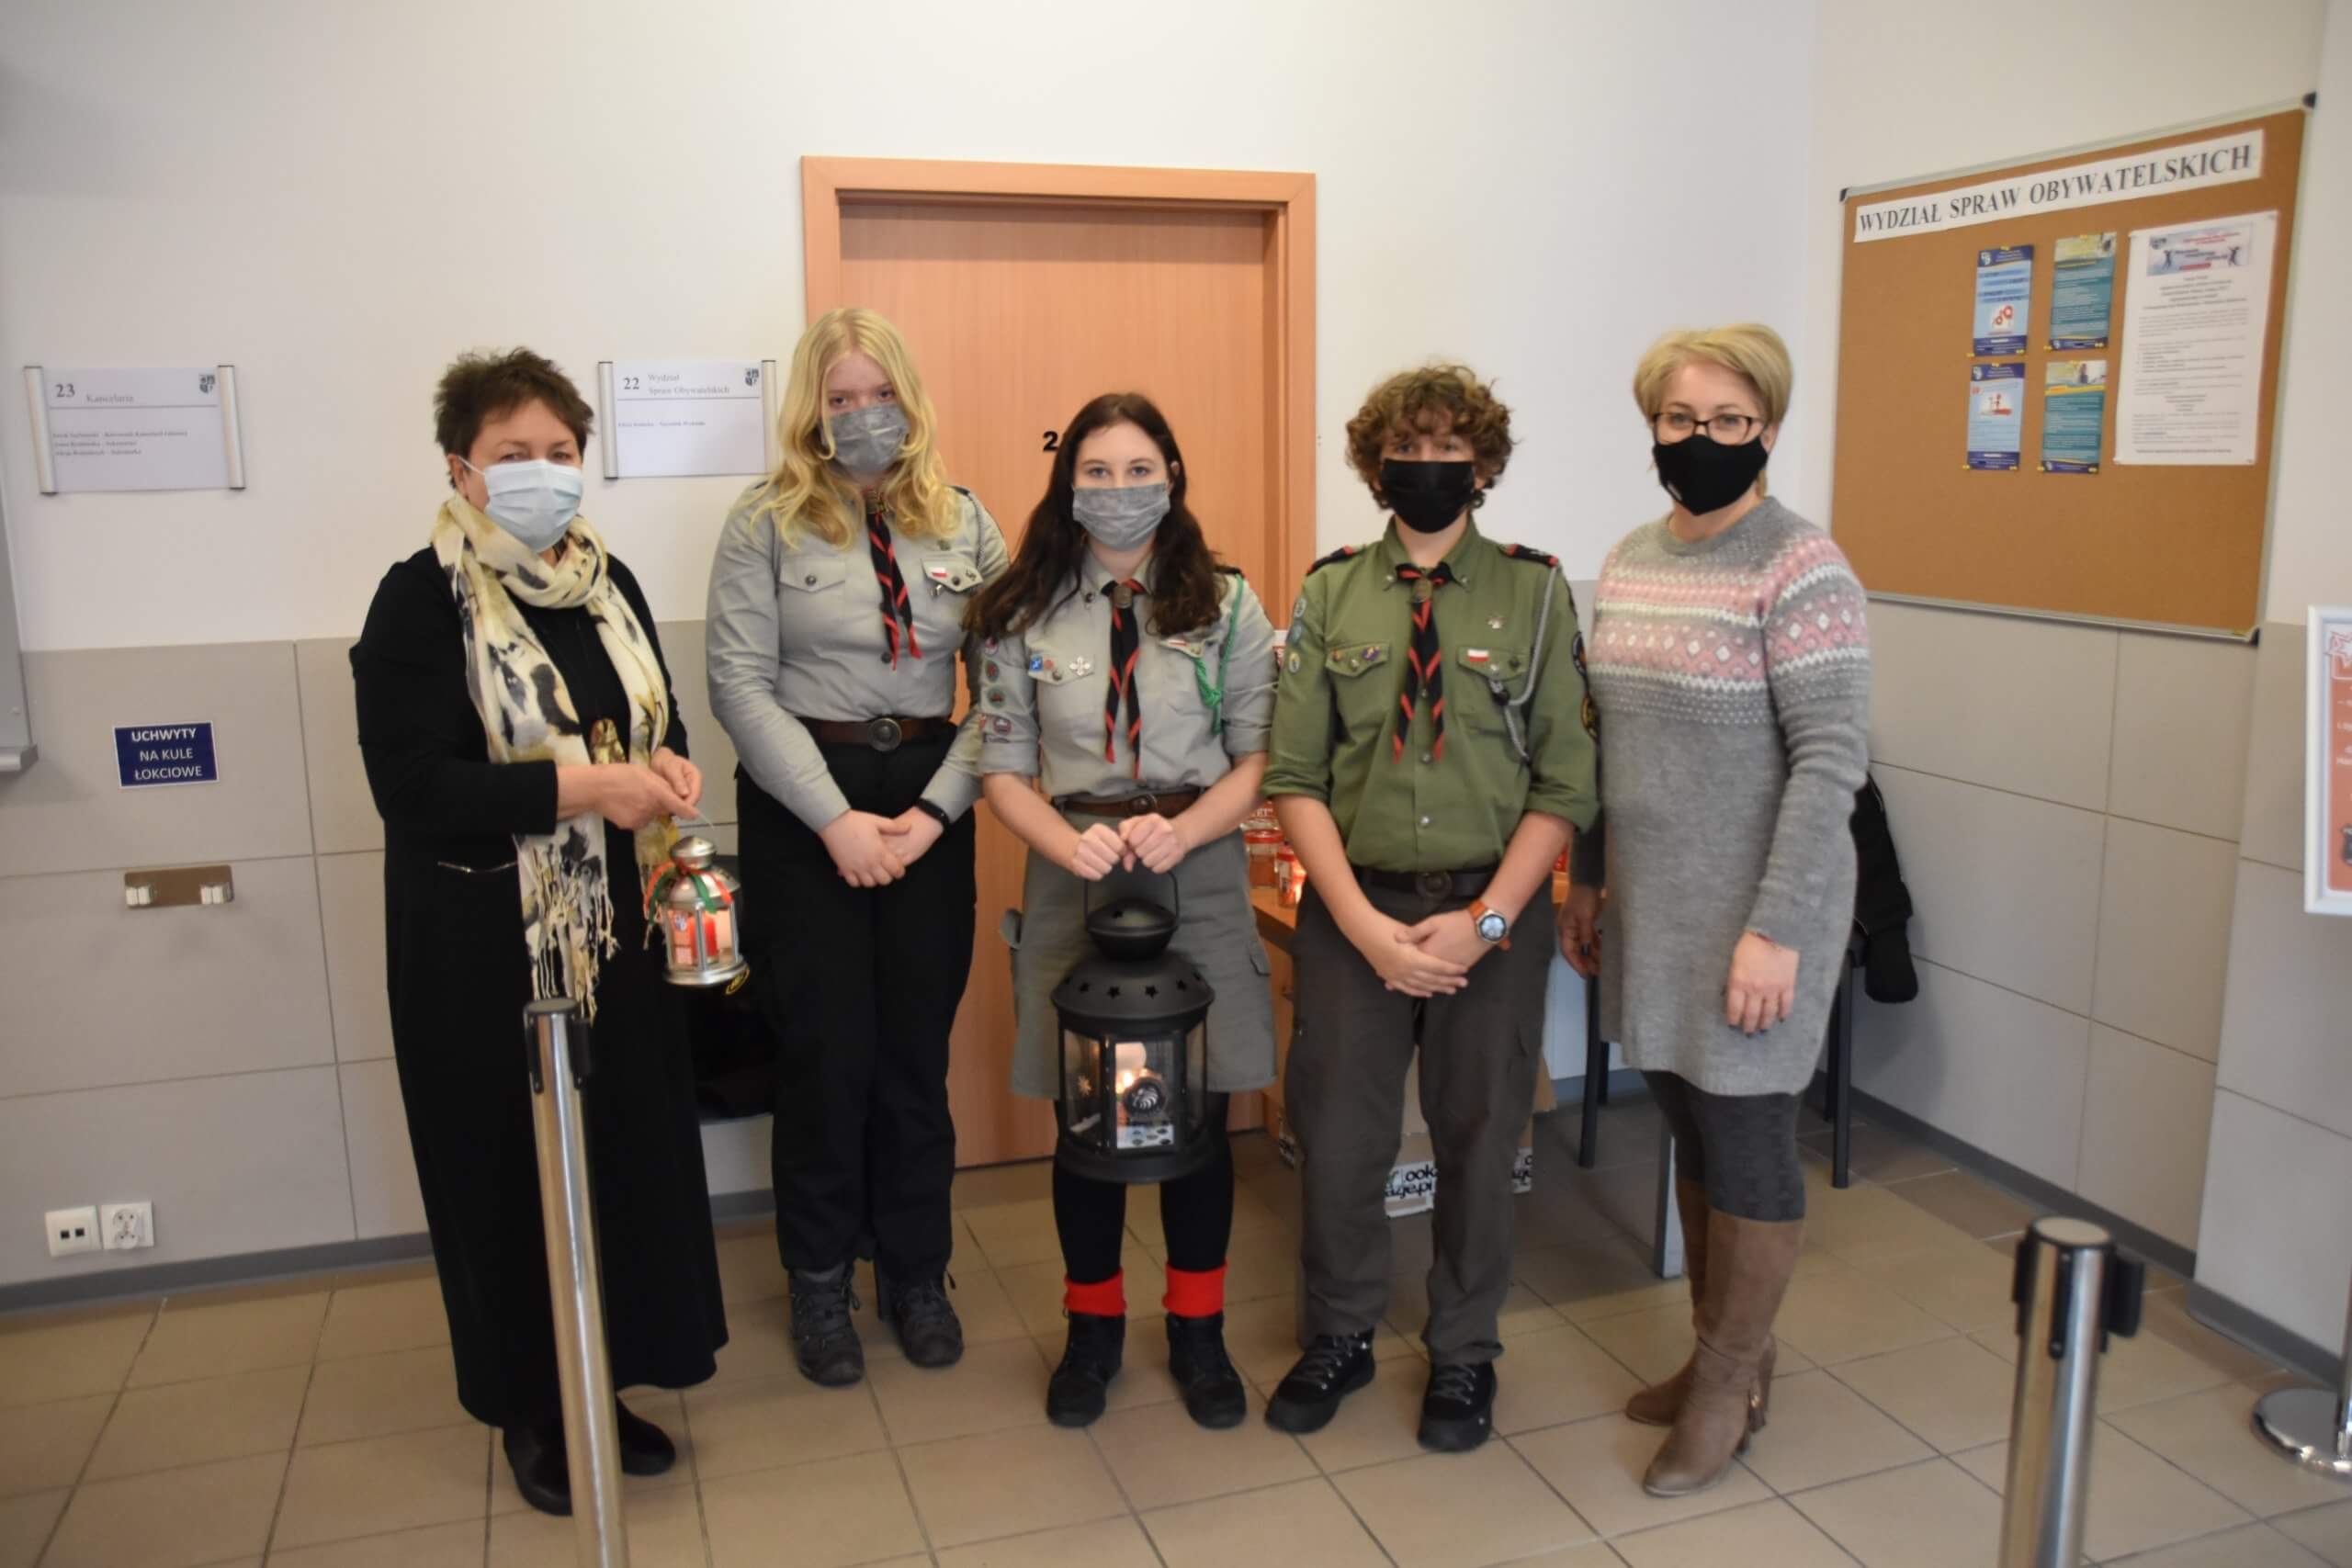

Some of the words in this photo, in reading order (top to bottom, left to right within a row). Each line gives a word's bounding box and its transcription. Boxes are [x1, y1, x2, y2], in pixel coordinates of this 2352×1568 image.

[1950, 187, 2020, 220] SPRAW
[2030, 144, 2252, 204] OBYWATELSKICH
[55, 383, 76, 398] 23
[623, 377, 640, 390] 22
[131, 728, 197, 742] UCHWYTY
[140, 750, 159, 761] NA
[162, 748, 194, 760] KULE
[134, 766, 203, 781] ŁOKCIOWE
